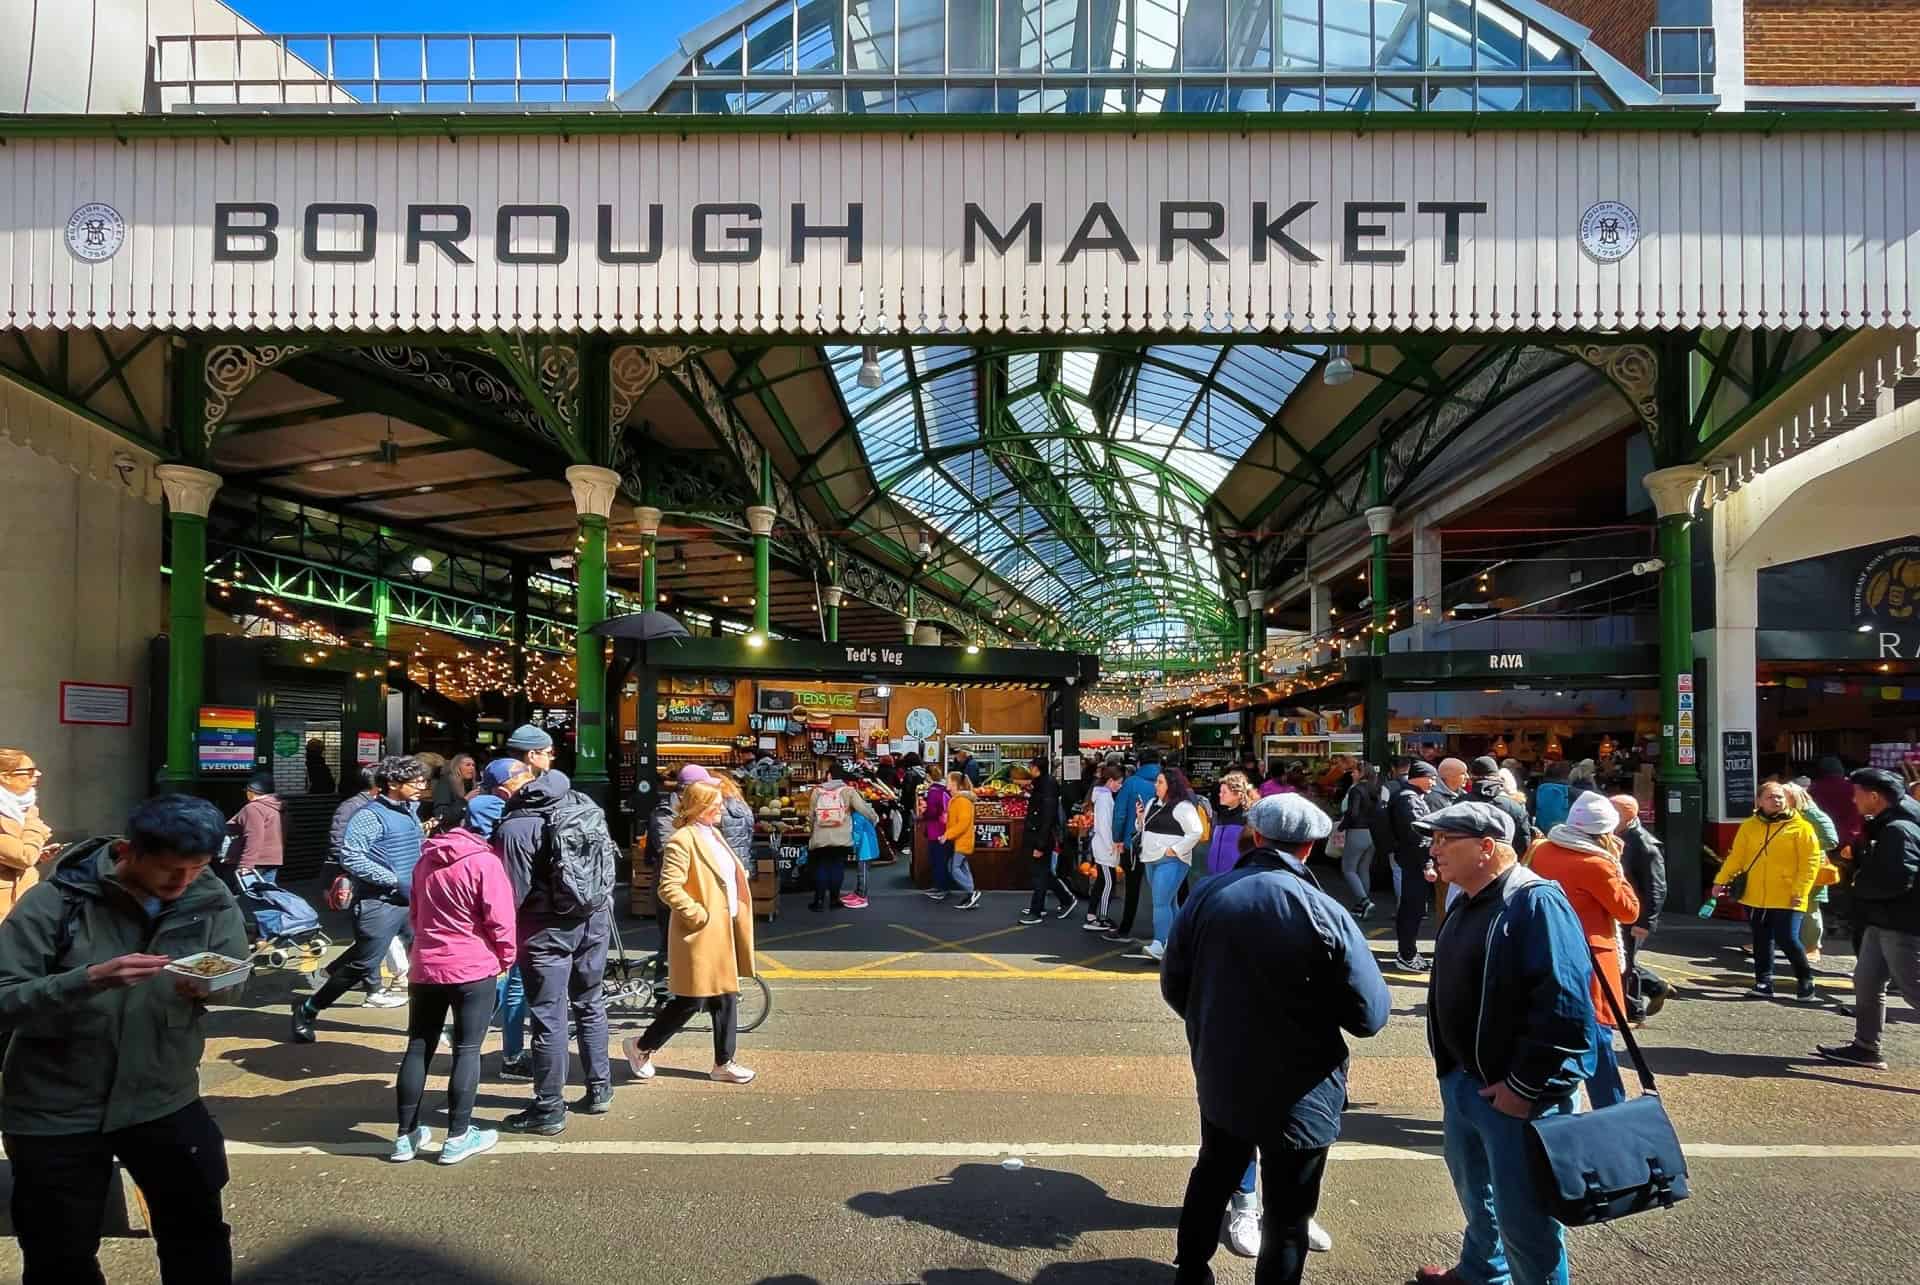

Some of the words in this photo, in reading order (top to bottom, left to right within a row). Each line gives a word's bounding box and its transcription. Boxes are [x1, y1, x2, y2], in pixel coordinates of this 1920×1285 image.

[214, 203, 863, 264] BOROUGH
[965, 201, 1487, 263] MARKET
[1879, 632, 1920, 658] R
[846, 648, 876, 662] Ted's
[882, 649, 902, 665] Veg
[1490, 655, 1523, 668] RAYA
[796, 692, 826, 705] TEDS
[829, 694, 853, 705] VEG
